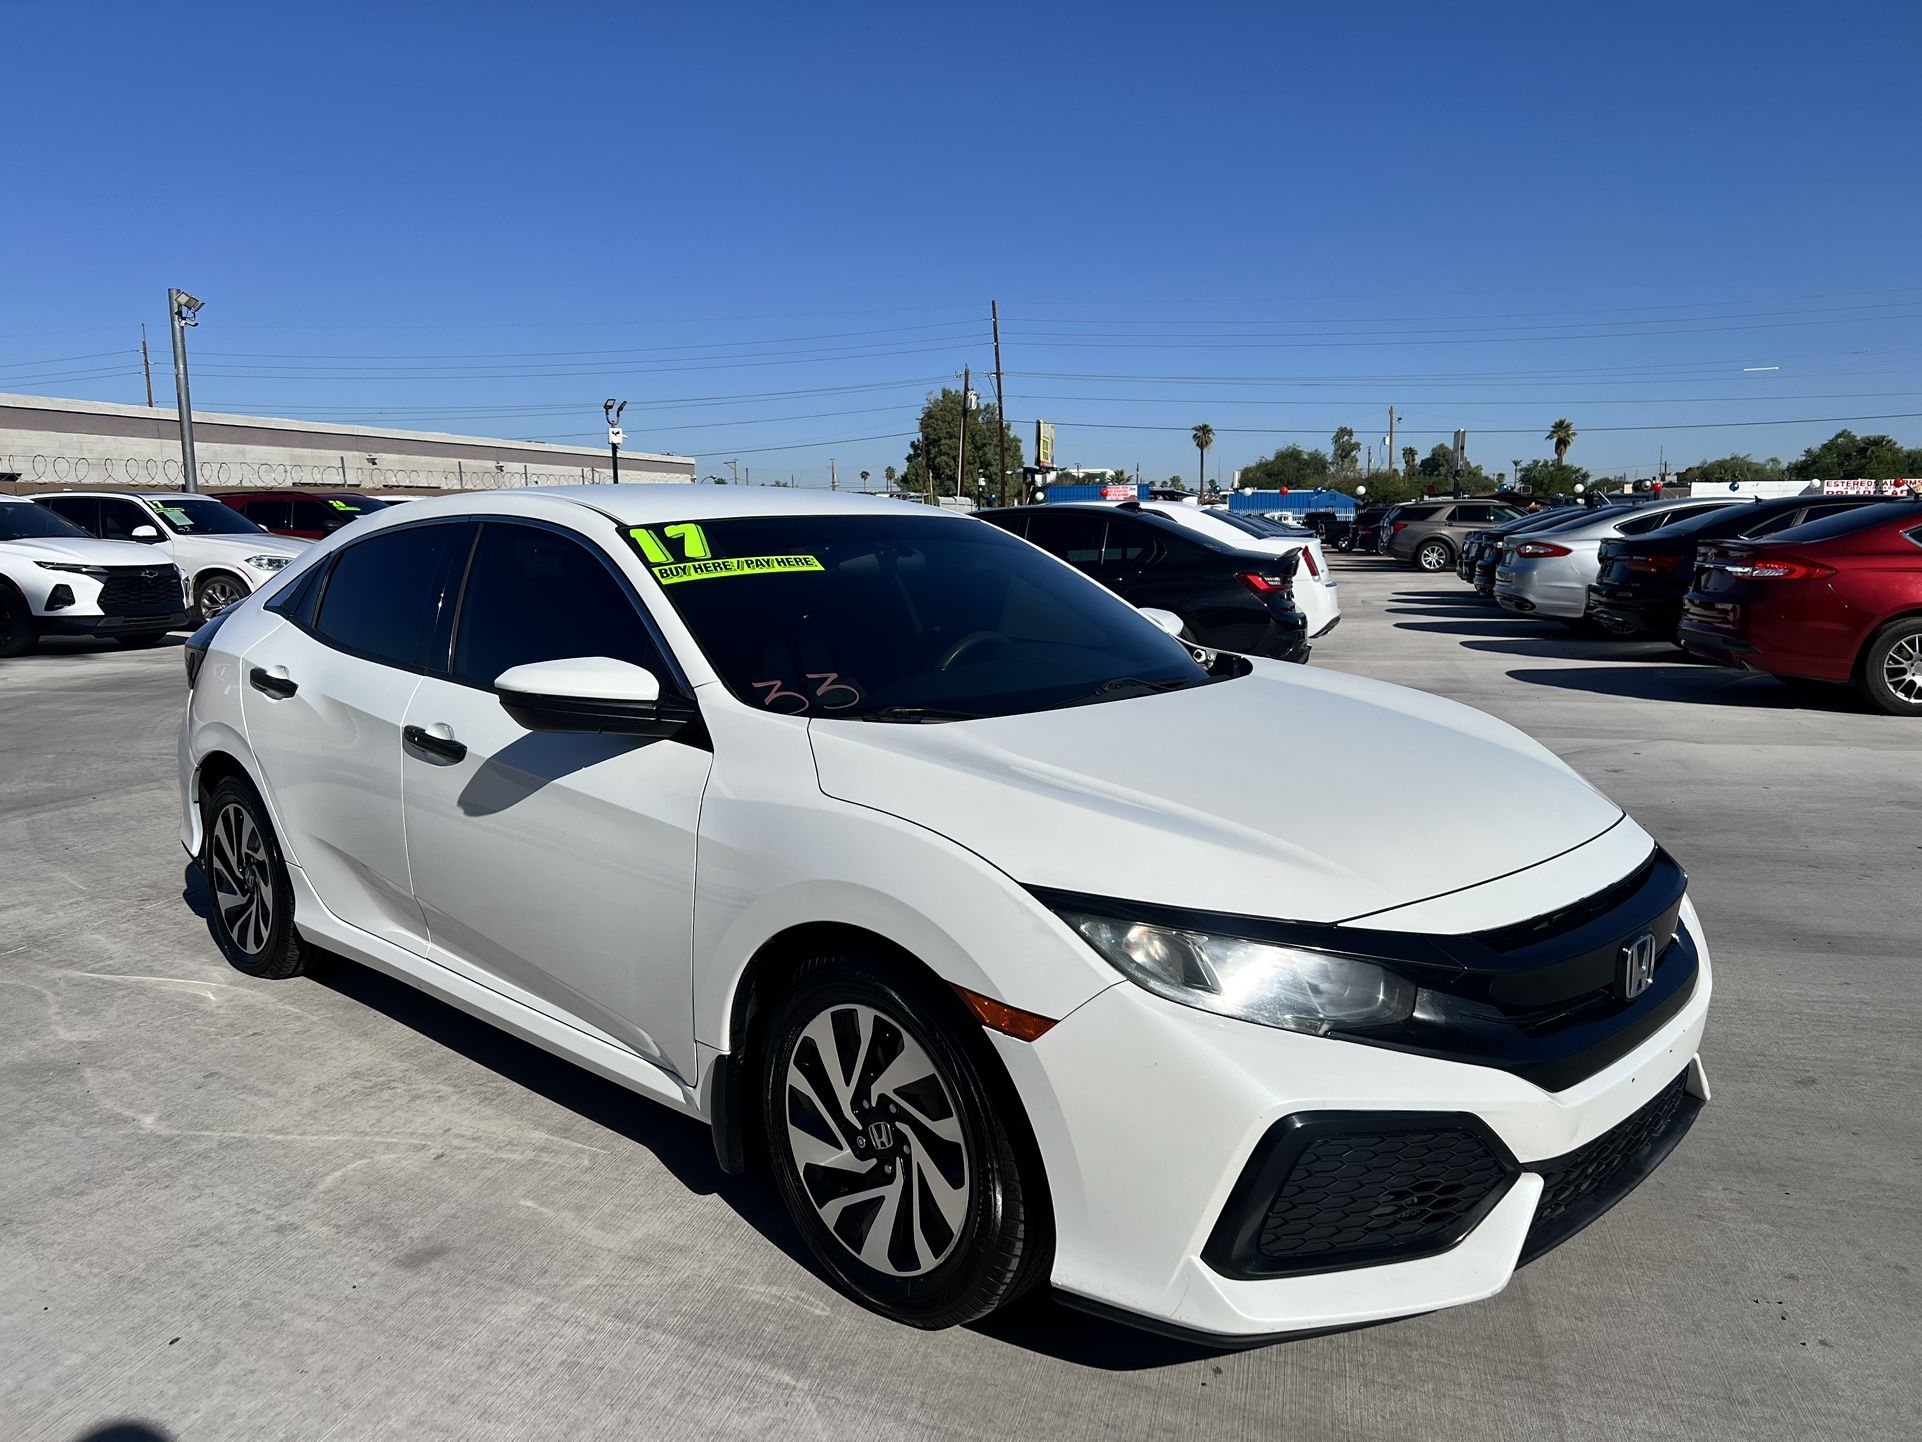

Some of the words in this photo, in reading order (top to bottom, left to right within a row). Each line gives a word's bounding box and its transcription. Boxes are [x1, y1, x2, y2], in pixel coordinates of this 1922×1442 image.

[629, 523, 711, 563] 17
[658, 566, 690, 580] BUY
[693, 561, 732, 574] HERE
[744, 558, 773, 569] PAY
[776, 557, 815, 568] HERE
[752, 673, 860, 715] 33
